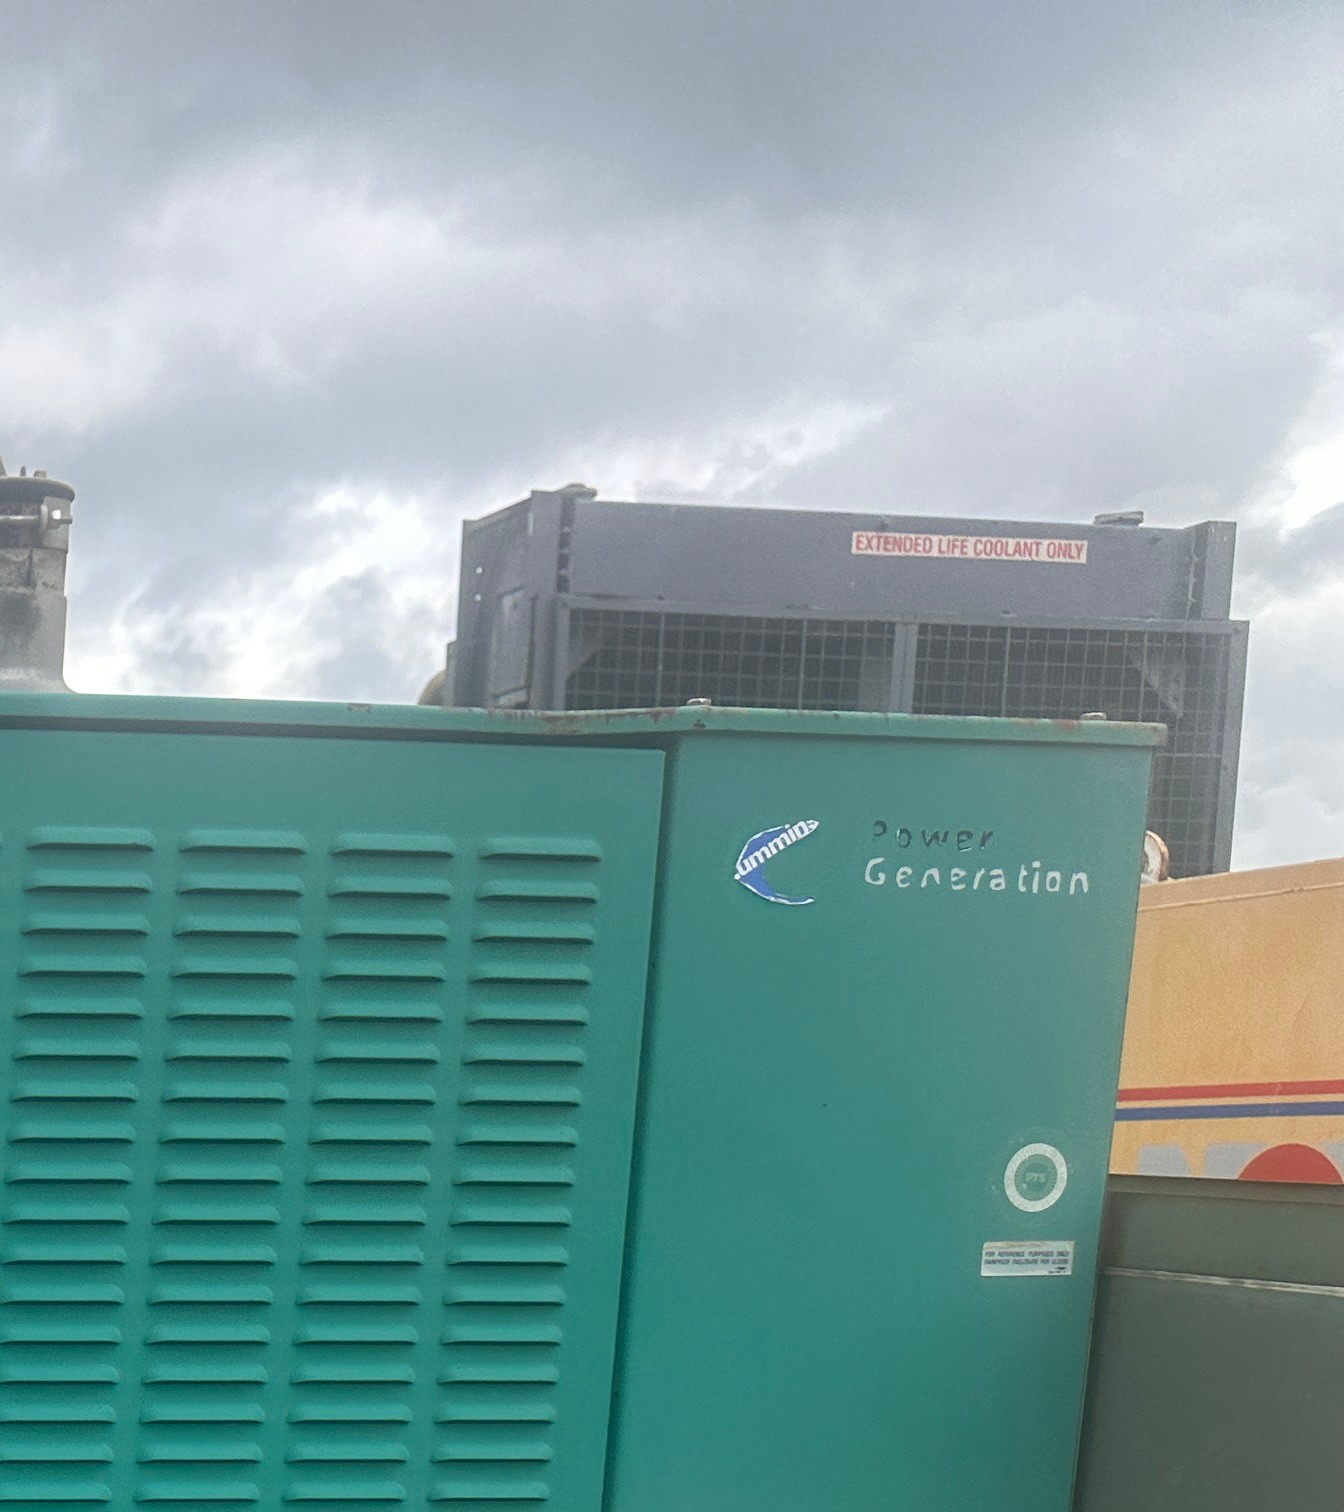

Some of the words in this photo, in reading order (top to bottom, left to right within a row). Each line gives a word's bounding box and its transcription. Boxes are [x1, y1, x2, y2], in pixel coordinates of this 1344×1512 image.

[855, 534, 933, 554] EXTENDED
[937, 537, 969, 556] LIFE
[973, 538, 1041, 559] COOLANT
[1046, 541, 1085, 560] ONLY
[863, 857, 1090, 895] Generation
